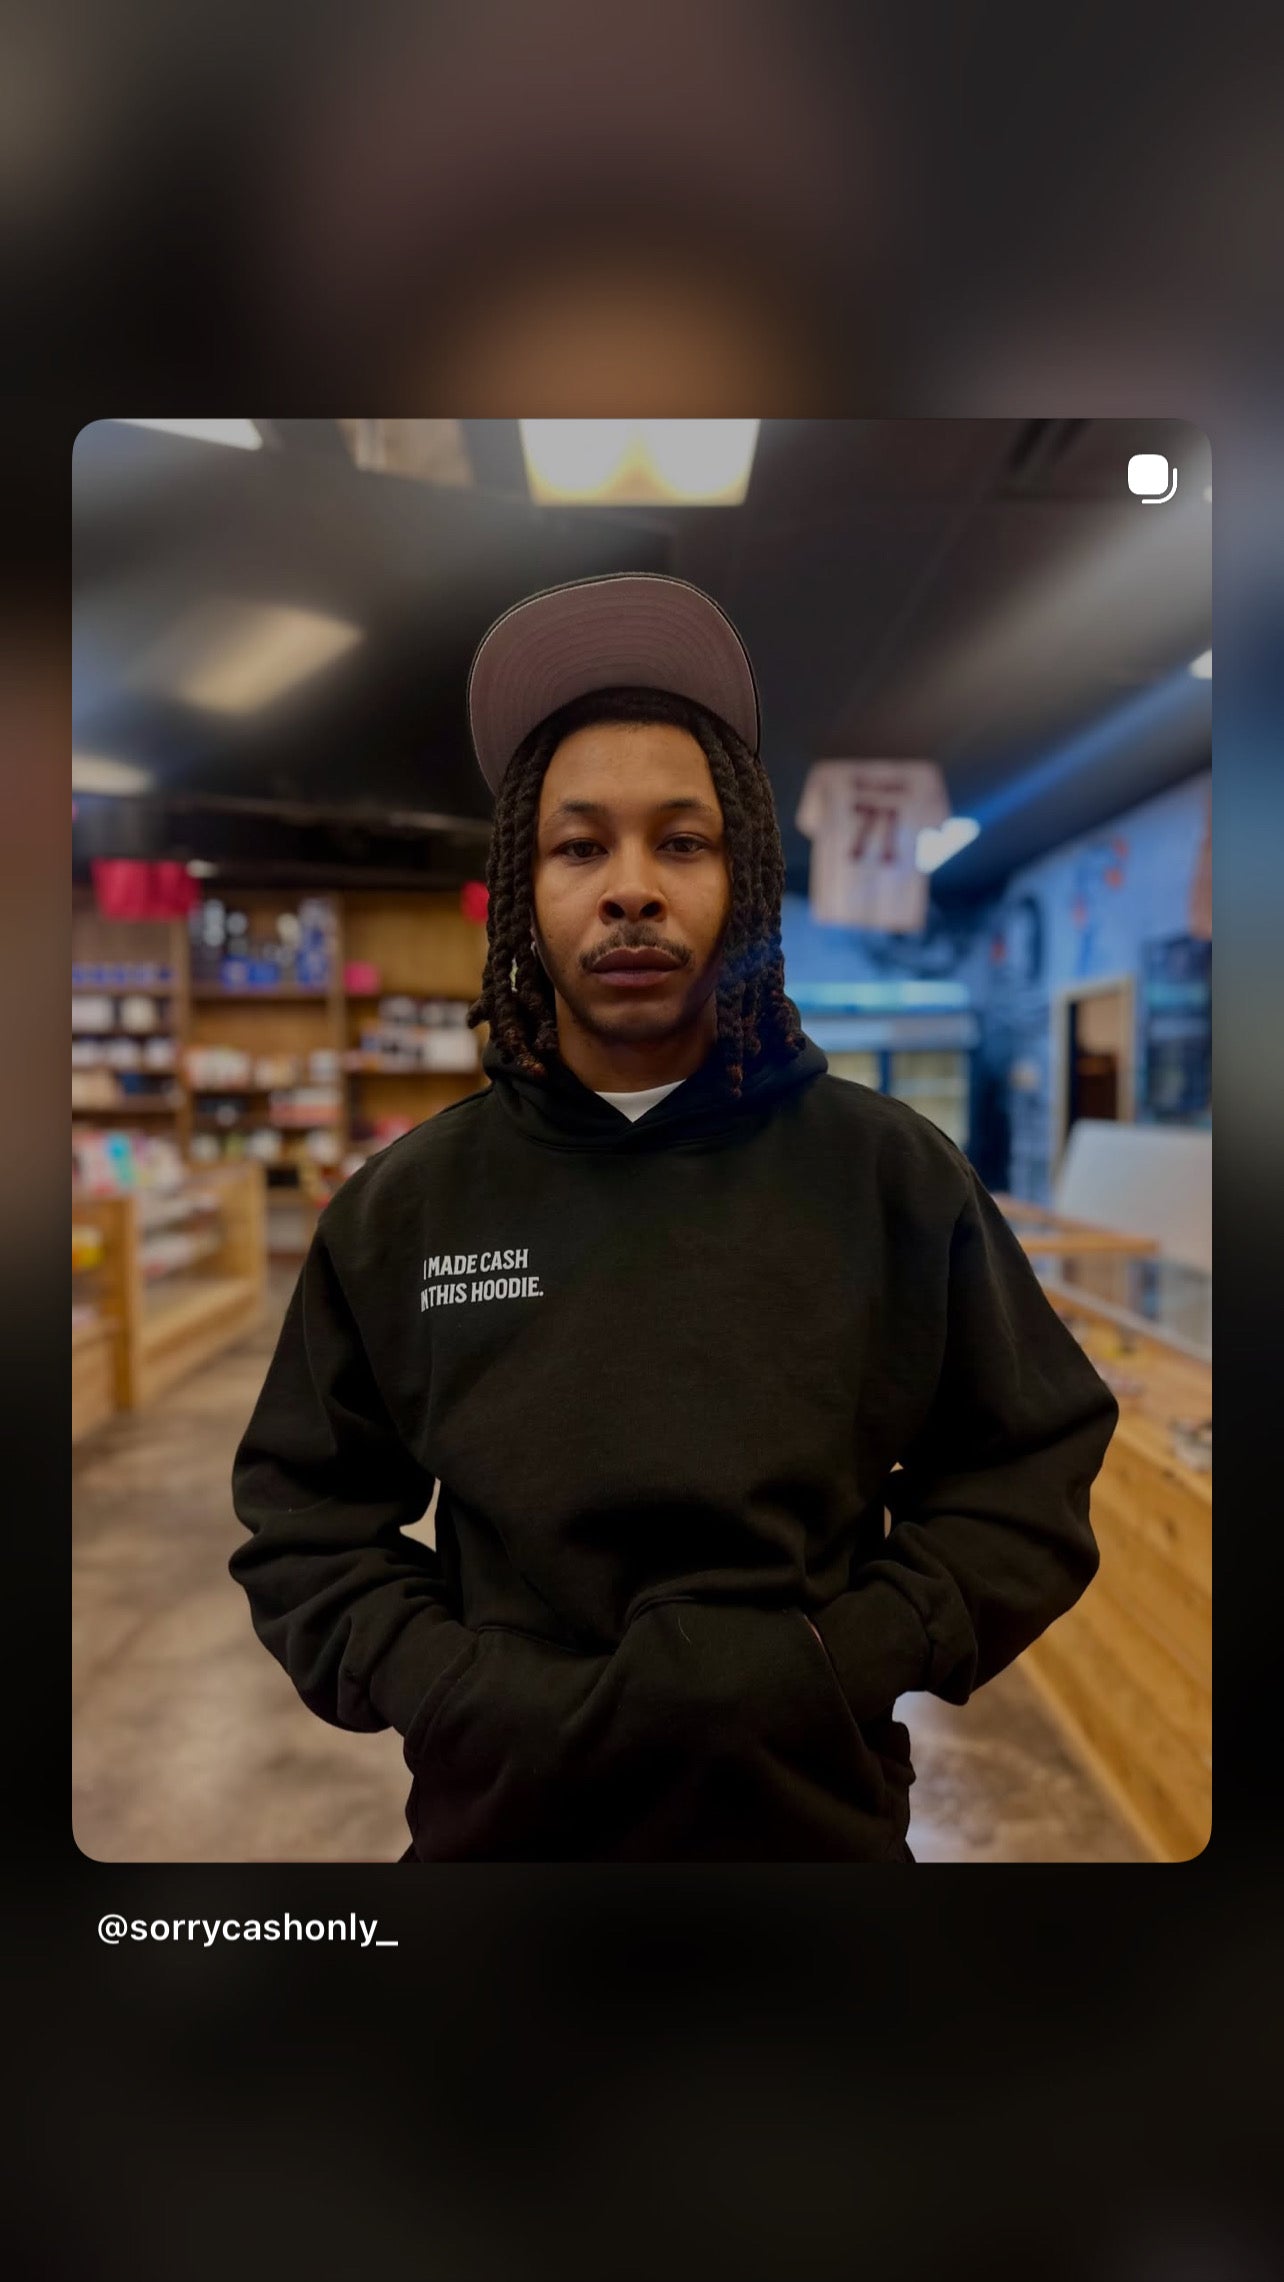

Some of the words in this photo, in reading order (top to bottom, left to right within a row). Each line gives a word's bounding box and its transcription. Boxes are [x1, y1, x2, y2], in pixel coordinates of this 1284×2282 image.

[851, 802, 898, 863] 71
[428, 1254, 478, 1278] MADE
[480, 1248, 529, 1272] CASH
[428, 1283, 467, 1307] THIS
[471, 1276, 544, 1303] HOODIE.
